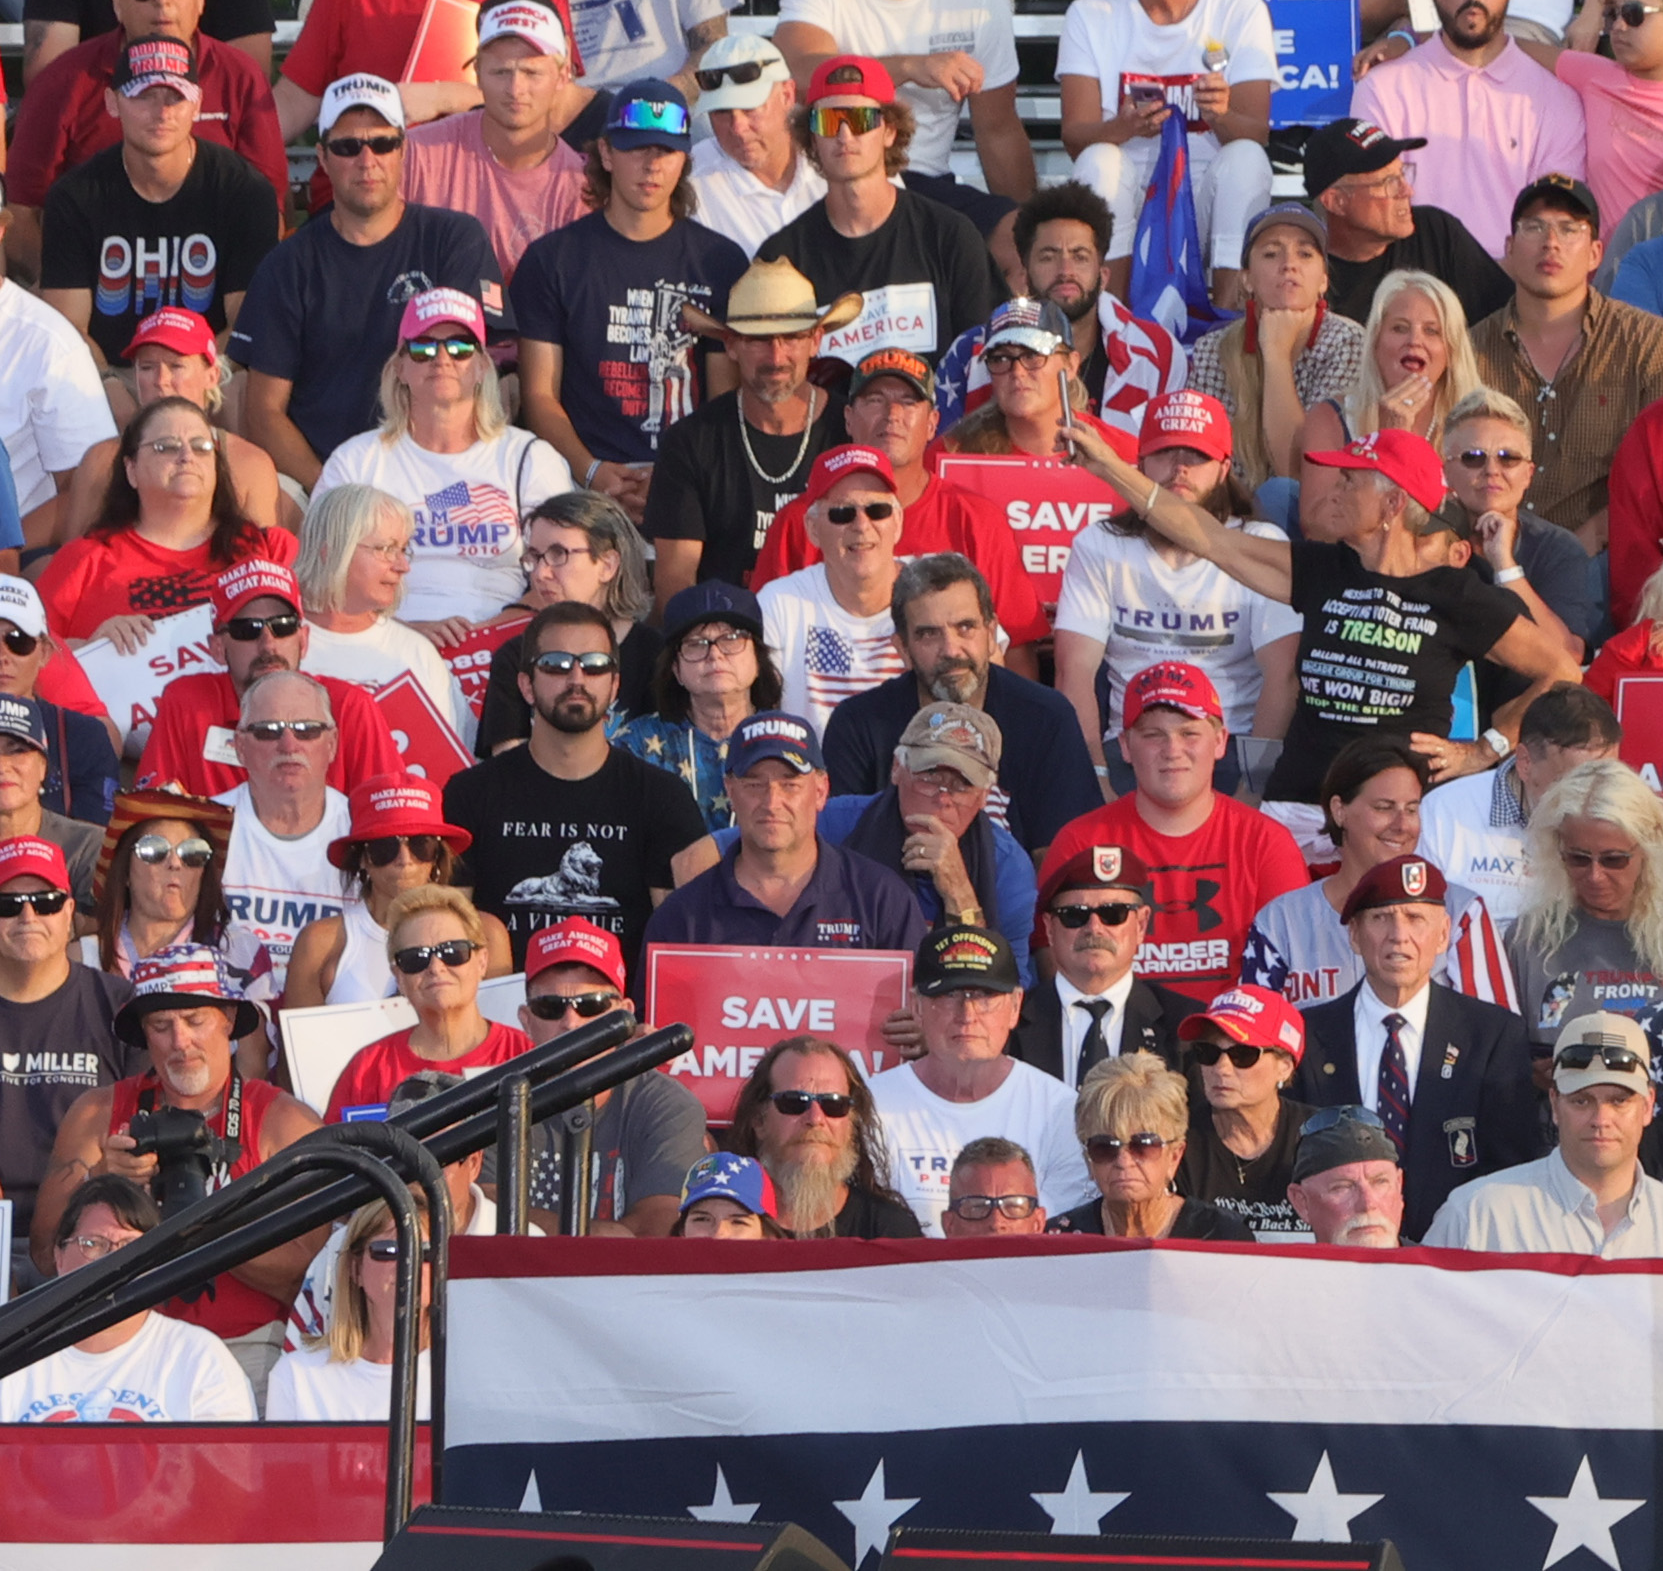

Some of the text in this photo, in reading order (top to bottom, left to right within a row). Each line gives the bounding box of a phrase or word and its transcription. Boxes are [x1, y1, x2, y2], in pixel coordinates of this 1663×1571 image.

[492, 5, 549, 28] AMERICA
[497, 17, 538, 30] FIRST
[130, 58, 190, 77] TRUMP
[333, 80, 390, 99] TRUMP
[99, 233, 217, 286] OHIO
[627, 288, 655, 308] WHEN
[416, 302, 478, 323] TRUMP
[608, 305, 653, 324] TYRANNY
[606, 323, 652, 343] BECOMES
[827, 314, 925, 352] AMERICA
[860, 352, 927, 379] TRUMP
[1168, 392, 1204, 405] KEEP
[1153, 404, 1214, 424] AMERICA
[1160, 417, 1207, 434] GREAT
[1005, 499, 1113, 532] SAVE
[456, 545, 500, 558] 2016
[217, 558, 293, 587] MAKE AMERICA
[225, 574, 292, 600] GREAT AGAIN
[1387, 590, 1404, 609] THE
[1115, 607, 1241, 633] TRUMP
[1372, 603, 1439, 637] VOTER FRAUD
[1324, 619, 1423, 655] IS TREASON
[1346, 655, 1409, 676] ALL PATRIOTS
[1301, 676, 1415, 708] WE WON BIG!!
[1334, 699, 1405, 717] THE STEAL
[742, 718, 809, 742] TRUMP
[369, 790, 397, 803] MAKE
[374, 800, 406, 811] GREAT
[502, 822, 629, 842] FEAR IS NOT
[1470, 857, 1516, 876] MAX
[506, 913, 518, 930] A
[817, 922, 861, 936] TRUMP
[538, 930, 609, 953] MAKE AMERICA
[542, 940, 604, 959] GREAT AGAIN
[934, 932, 998, 956] TET OFFENSIVE
[1130, 956, 1230, 975] ARMOUR
[1593, 983, 1658, 1000] FRONT
[722, 996, 837, 1031] SAVE
[25, 1051, 99, 1072] MILLER
[24, 1075, 98, 1087] FOR CONGRESS
[226, 1098, 240, 1139] EOS 7D
[1262, 1217, 1292, 1231] Back
